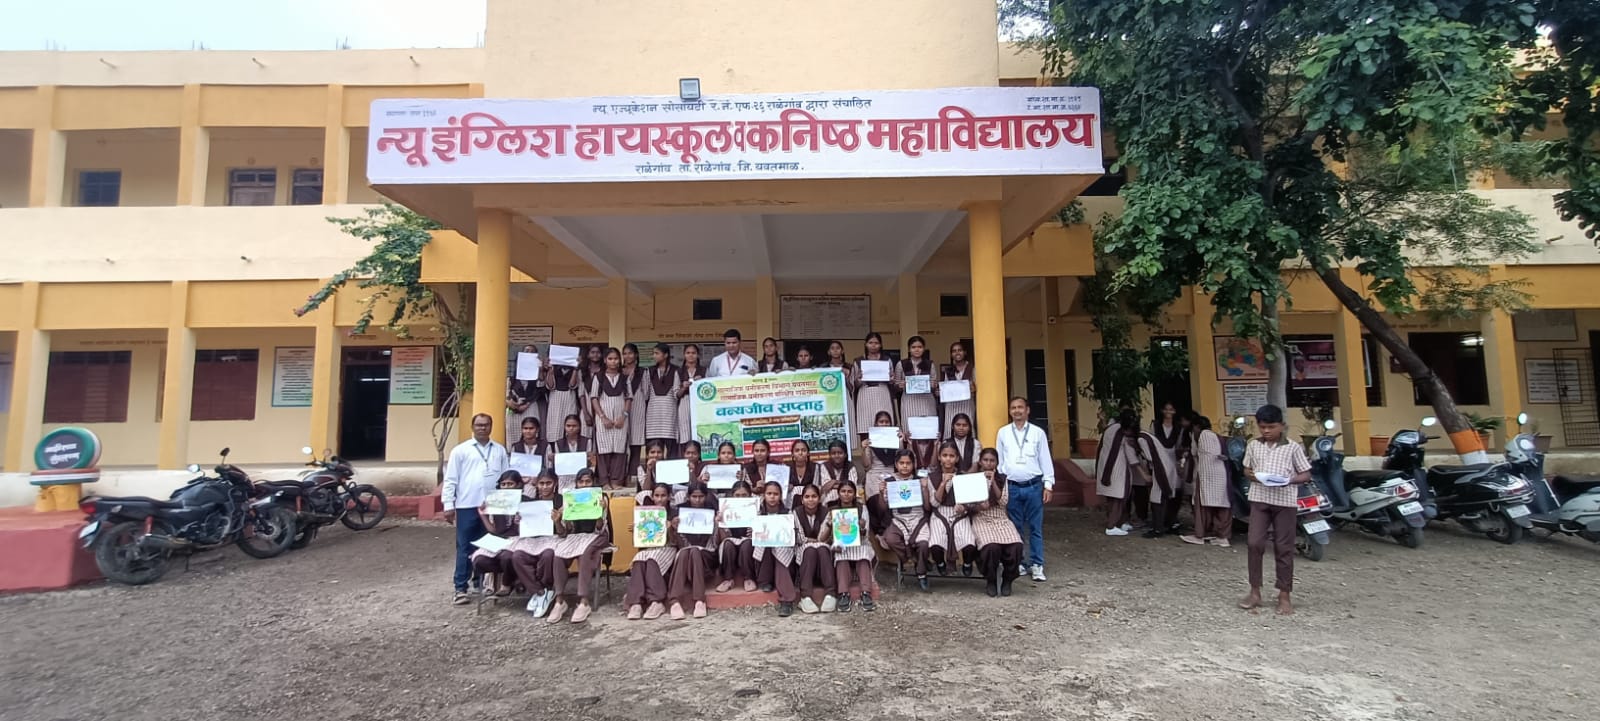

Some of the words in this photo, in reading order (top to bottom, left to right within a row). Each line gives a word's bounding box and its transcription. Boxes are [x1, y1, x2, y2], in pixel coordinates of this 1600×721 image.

[805, 100, 829, 112] द्वारा
[832, 96, 873, 108] संचालित
[377, 127, 428, 165] न्यू
[432, 112, 571, 162] इंग्लिश
[574, 121, 733, 163] हायस्कूल
[747, 109, 862, 152] कनिष्ठ
[866, 105, 1096, 157] महाविद्यालय
[715, 403, 774, 417] वन्यजीव
[778, 400, 825, 414] सप्ताह
